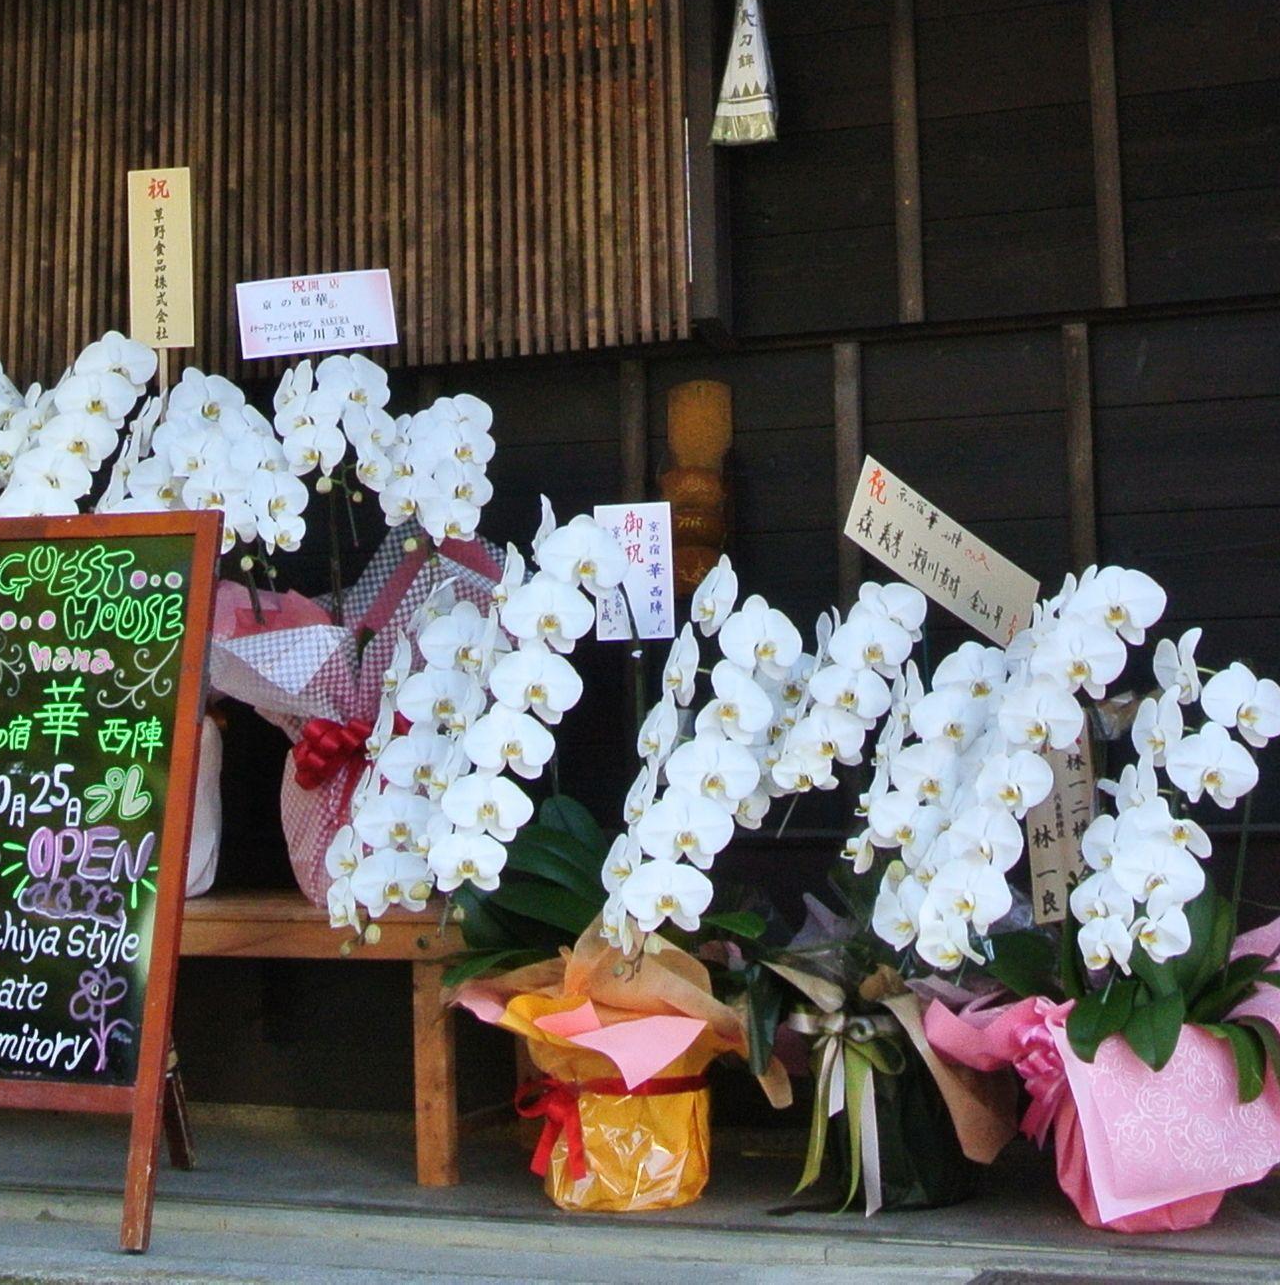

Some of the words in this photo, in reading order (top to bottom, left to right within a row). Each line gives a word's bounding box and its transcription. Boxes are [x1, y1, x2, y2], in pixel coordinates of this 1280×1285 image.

[147, 178, 170, 200] 祝
[63, 594, 185, 645] HOUSE
[33, 676, 90, 756] 華
[97, 715, 164, 763] 西陣
[83, 764, 152, 823] プレ
[27, 825, 156, 883] OPEN
